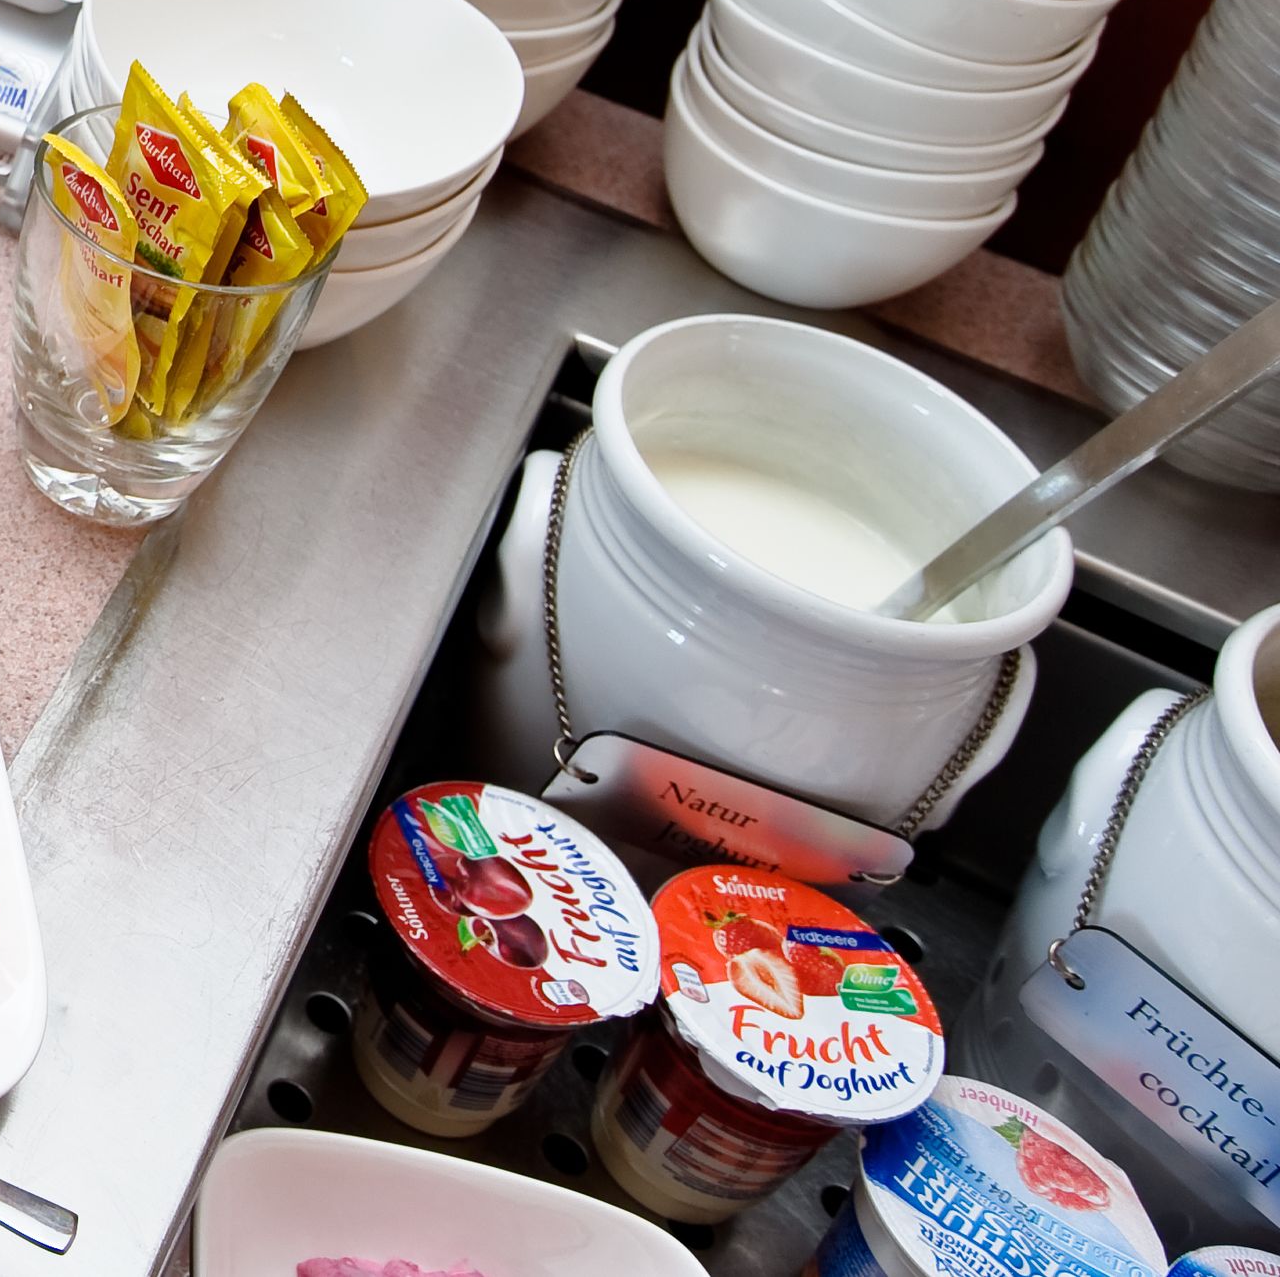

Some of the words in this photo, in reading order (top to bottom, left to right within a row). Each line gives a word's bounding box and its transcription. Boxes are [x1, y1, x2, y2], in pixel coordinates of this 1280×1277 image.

[138, 129, 199, 196] Burkhardt
[127, 172, 179, 224] Senf
[659, 781, 759, 828] Natur
[499, 833, 607, 968] Frucht
[535, 823, 629, 924] Joghurt
[596, 920, 640, 972] auf
[792, 929, 858, 947] Erdbeere
[850, 969, 892, 986] Ohne
[729, 1005, 891, 1065] Frucht
[1125, 997, 1276, 1127] Früchte-
[736, 1050, 794, 1089] auf
[799, 1062, 915, 1101] Joghurt
[960, 1087, 1038, 1126] Himbeer
[1140, 1072, 1280, 1188] cocktail
[894, 1175, 1040, 1277] GHURT
